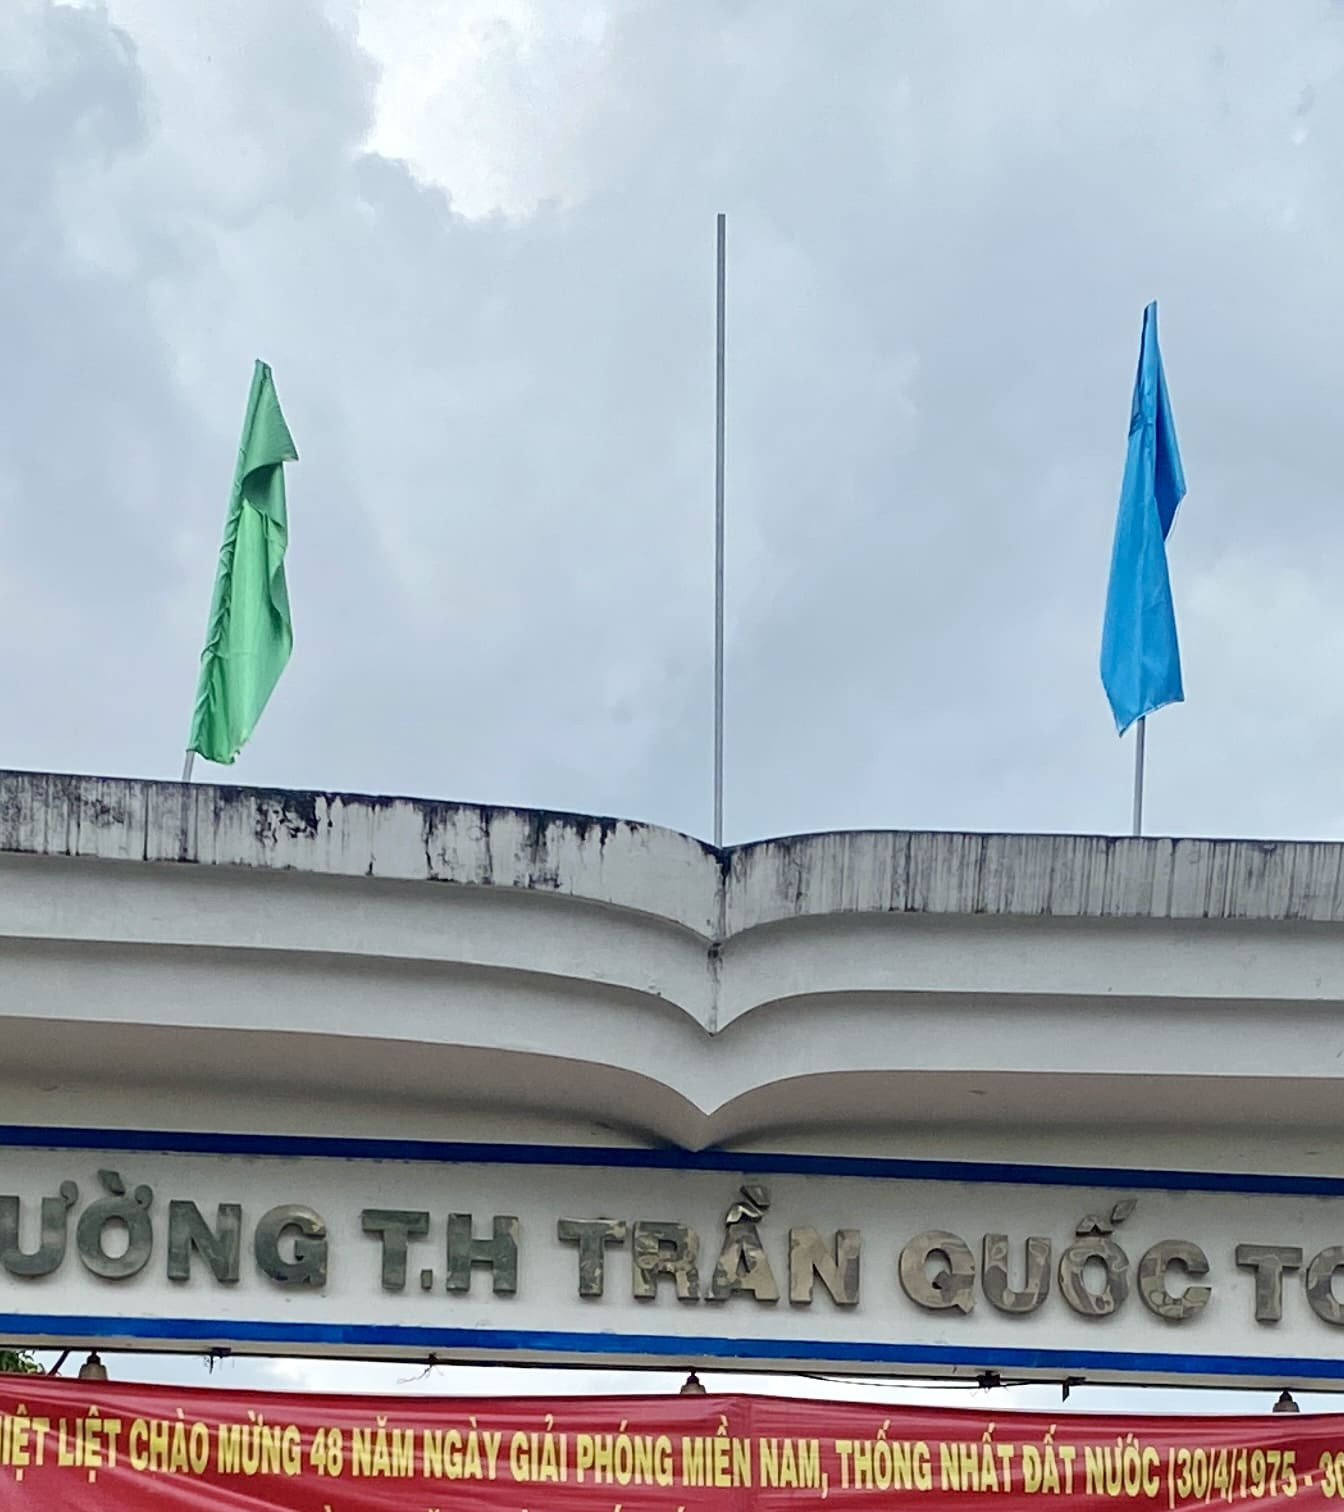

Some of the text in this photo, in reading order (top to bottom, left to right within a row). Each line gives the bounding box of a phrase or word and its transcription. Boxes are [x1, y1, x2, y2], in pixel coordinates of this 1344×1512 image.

[362, 1208, 518, 1302] T.H
[558, 1184, 860, 1306] TRẦN
[899, 1199, 1213, 1322] QUỐC
[58, 1405, 122, 1483] LIỆT
[130, 1408, 210, 1475] CHÀO
[217, 1410, 301, 1479] MỪNG
[310, 1443, 343, 1478] 48
[353, 1416, 415, 1479] NĂM
[423, 1416, 499, 1482] NGÀY
[509, 1415, 568, 1483] GIẢI
[576, 1418, 673, 1487] PHÓNG
[681, 1415, 751, 1490] MIỀN
[761, 1438, 829, 1499] NAM,
[836, 1419, 931, 1491] THỐNG
[940, 1421, 1014, 1493] NHẤT
[1022, 1422, 1078, 1495] ĐẤT
[1084, 1433, 1160, 1499] NƯỚC
[1167, 1447, 1297, 1511] (30/4/1975
